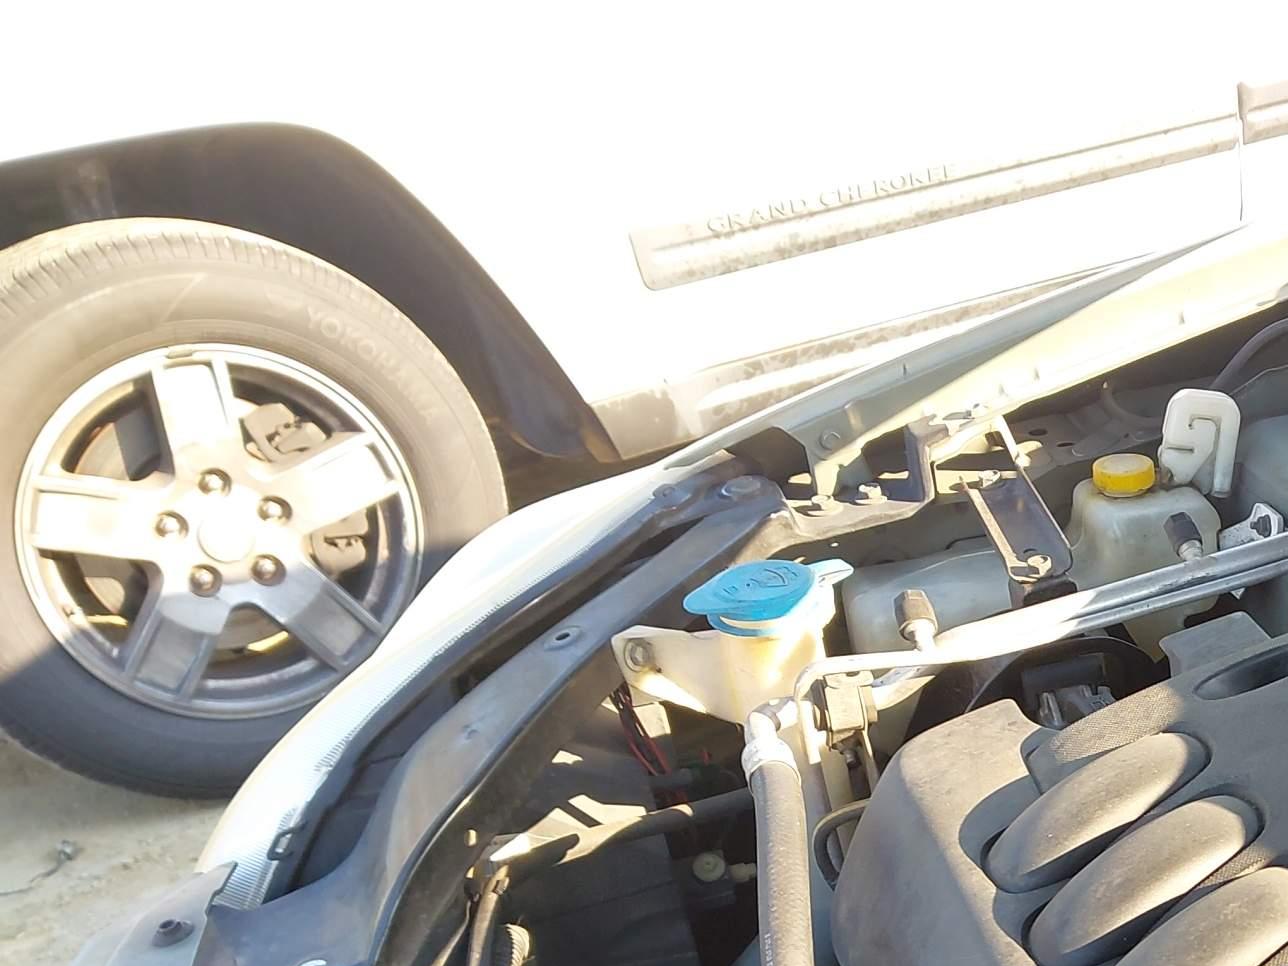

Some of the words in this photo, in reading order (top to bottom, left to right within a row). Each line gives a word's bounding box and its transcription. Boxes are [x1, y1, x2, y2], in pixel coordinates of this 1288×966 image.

[705, 198, 808, 235] GRAND
[819, 163, 957, 209] CHEROKEE
[306, 304, 440, 424] YOKOHAMA
